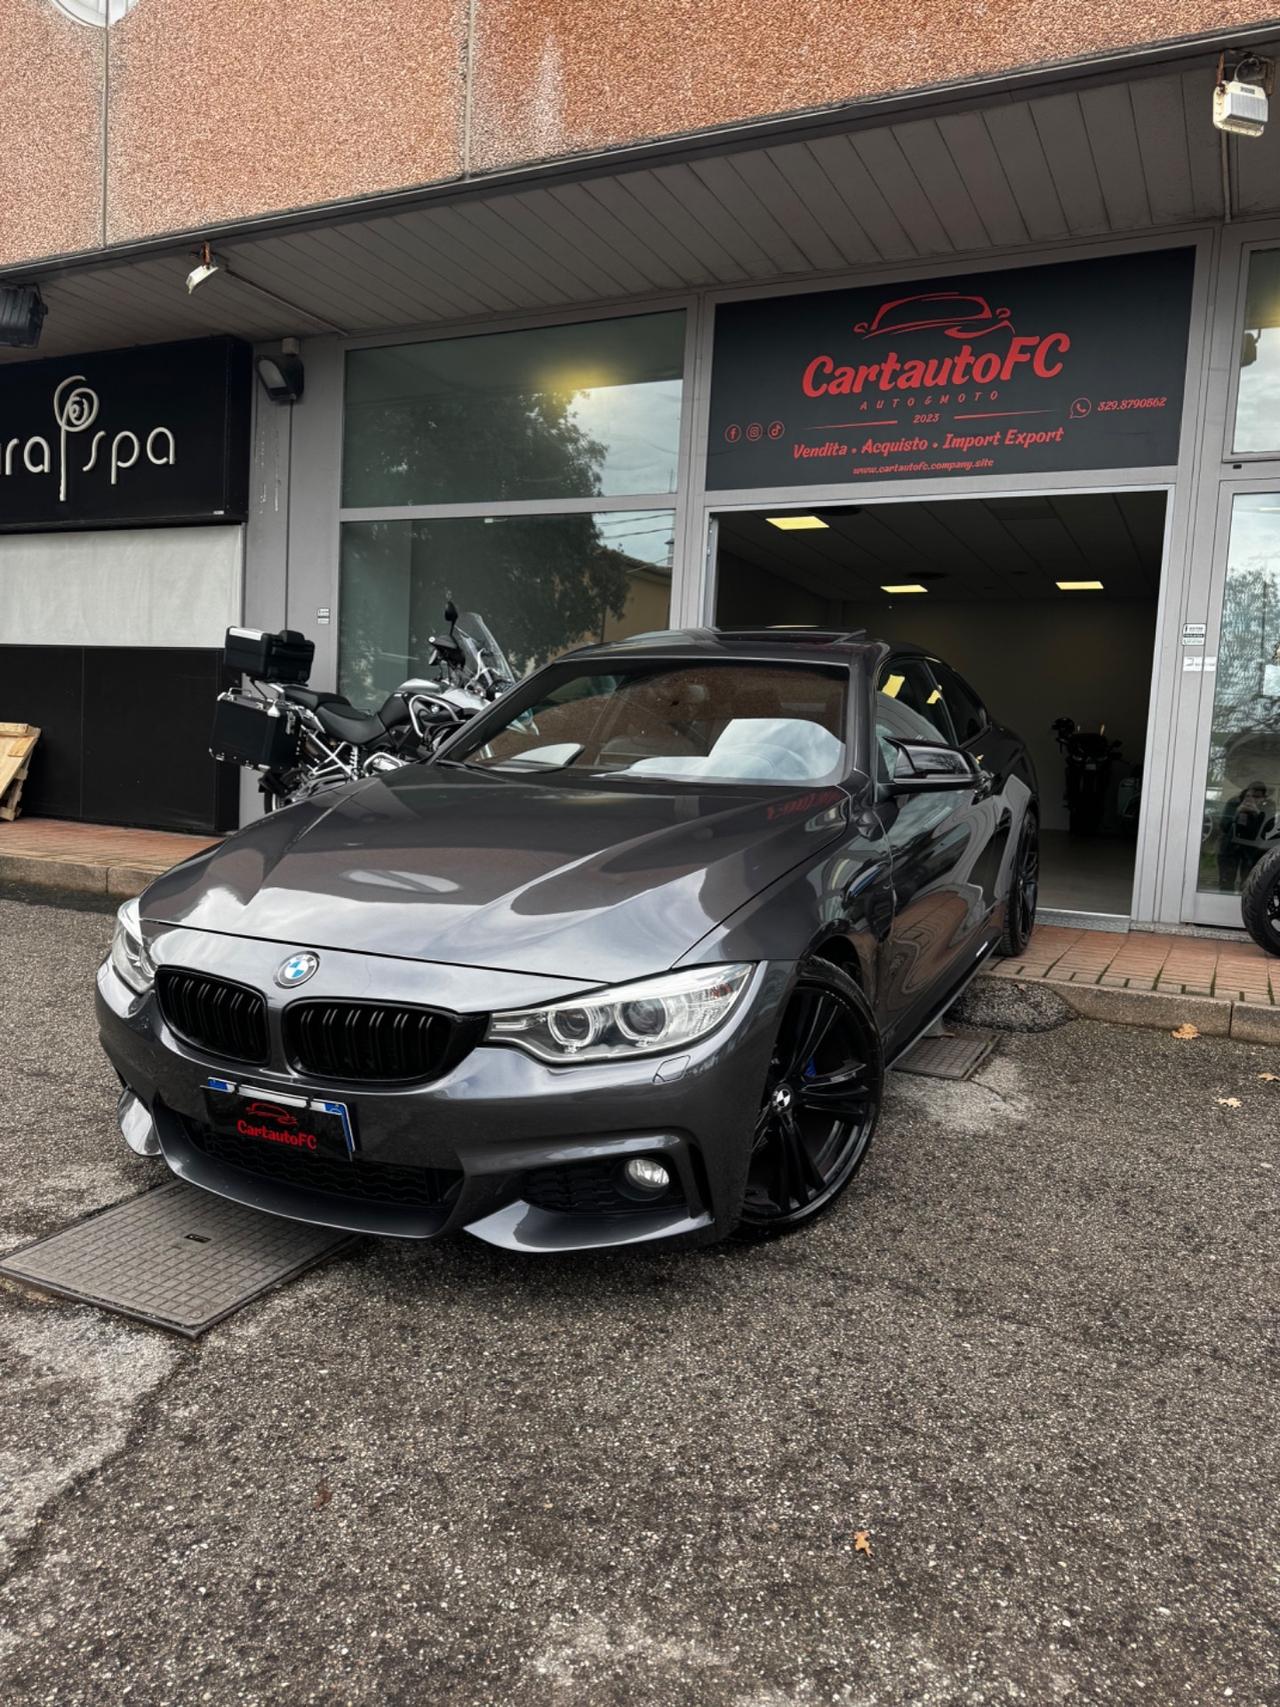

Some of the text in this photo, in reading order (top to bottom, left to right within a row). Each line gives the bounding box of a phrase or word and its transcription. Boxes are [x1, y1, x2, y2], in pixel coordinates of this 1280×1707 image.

[802, 332, 1071, 398] CartautoFC
[912, 413, 941, 424] 2023
[0, 427, 175, 485] ra spa
[793, 426, 1064, 459] Vendita Acquisto Import Export
[853, 459, 994, 475] www.cartautofc.company.site
[237, 1119, 318, 1150] CartautoFC
